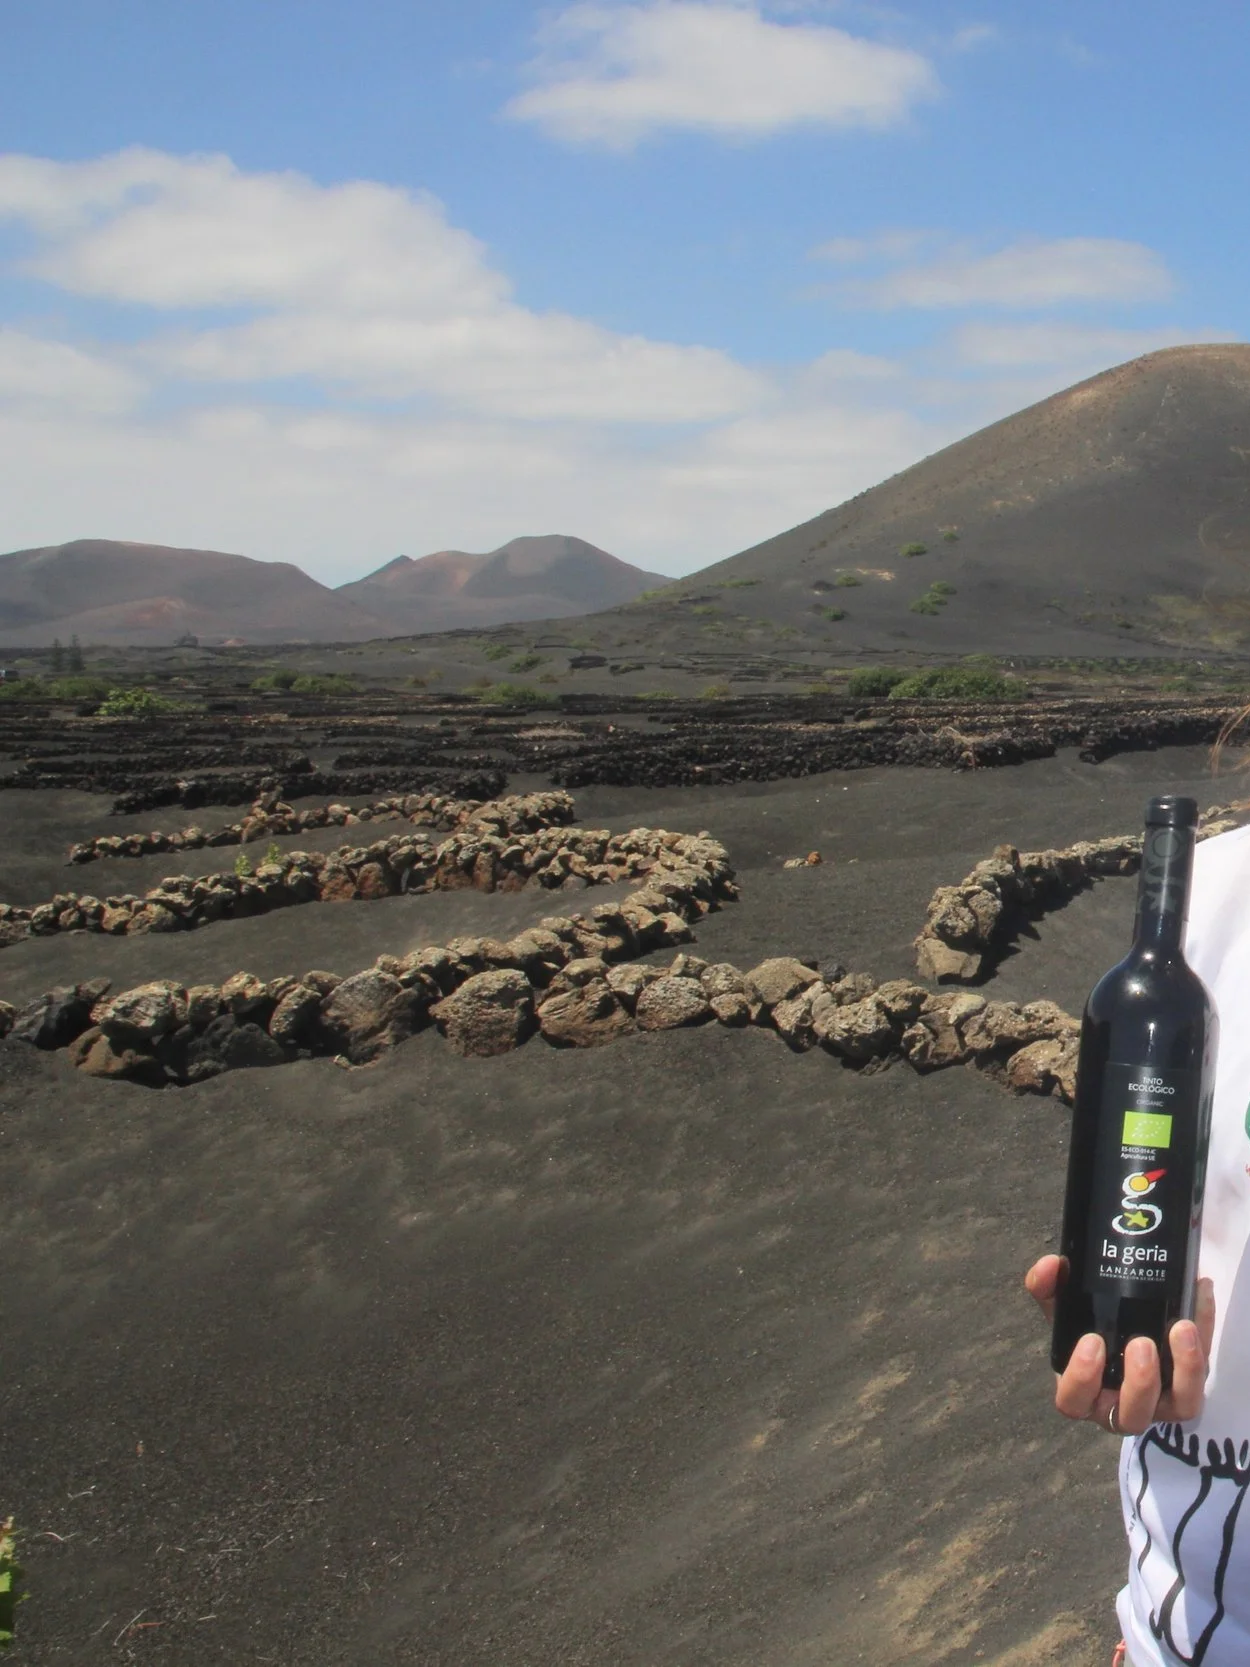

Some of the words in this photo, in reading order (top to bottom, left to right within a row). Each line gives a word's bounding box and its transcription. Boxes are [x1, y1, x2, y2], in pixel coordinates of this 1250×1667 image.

[1143, 1077, 1163, 1086] TINTO
[1102, 1239, 1118, 1258] la
[1122, 1245, 1167, 1265] geria
[1100, 1264, 1166, 1277] LANZAROTE
